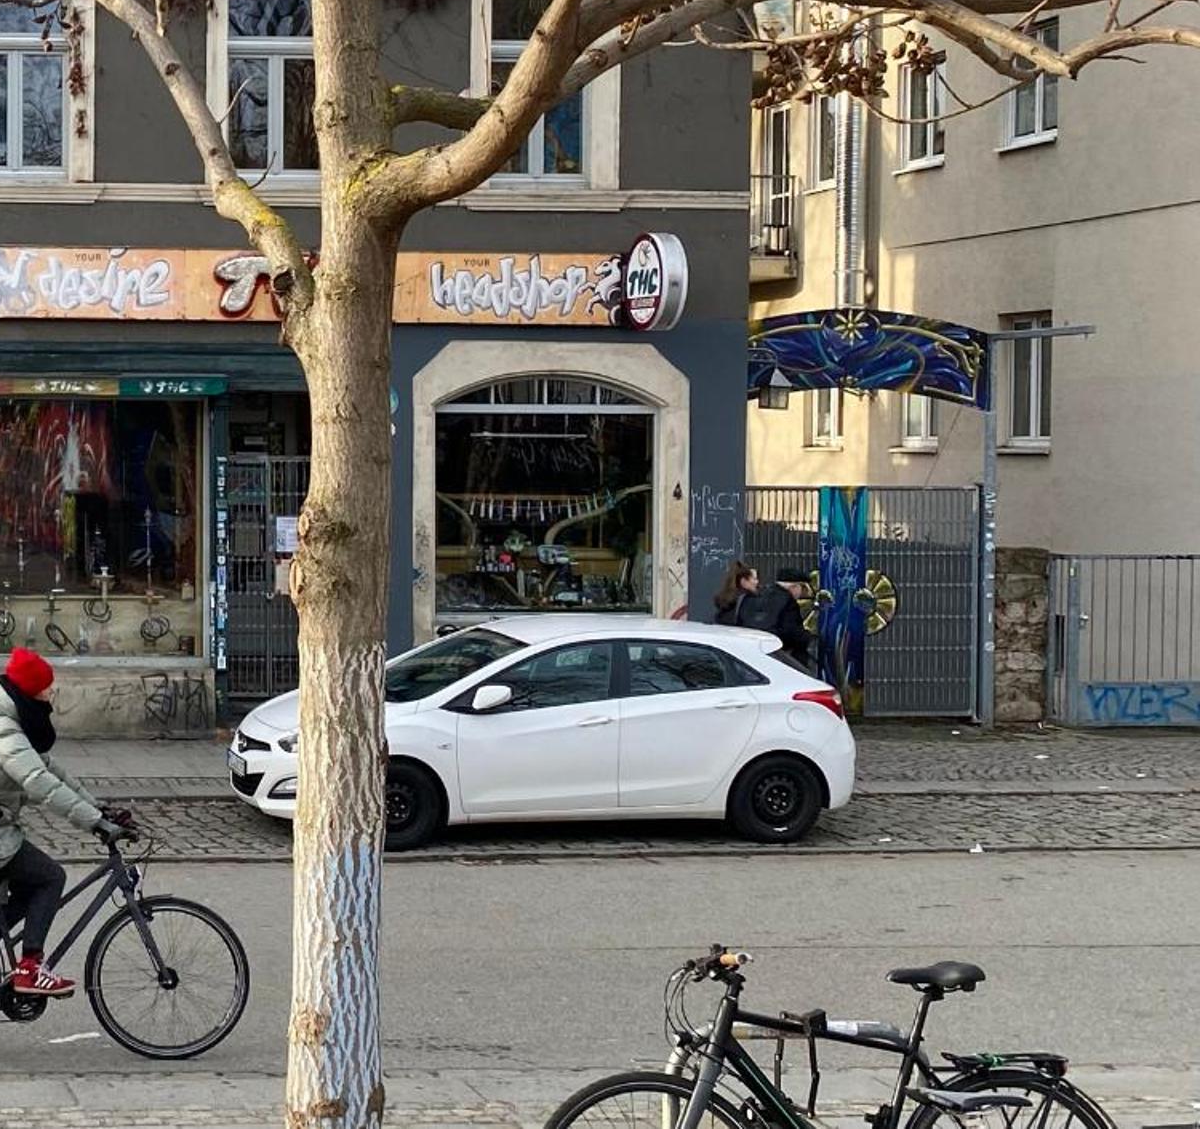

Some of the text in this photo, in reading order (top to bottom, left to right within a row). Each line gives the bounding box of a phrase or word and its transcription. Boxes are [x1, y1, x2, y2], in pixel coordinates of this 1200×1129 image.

[75, 253, 102, 262] YOUR
[464, 258, 490, 267] YOUR
[38, 246, 171, 313] desire
[430, 254, 588, 320] headshop
[628, 267, 659, 297] THC
